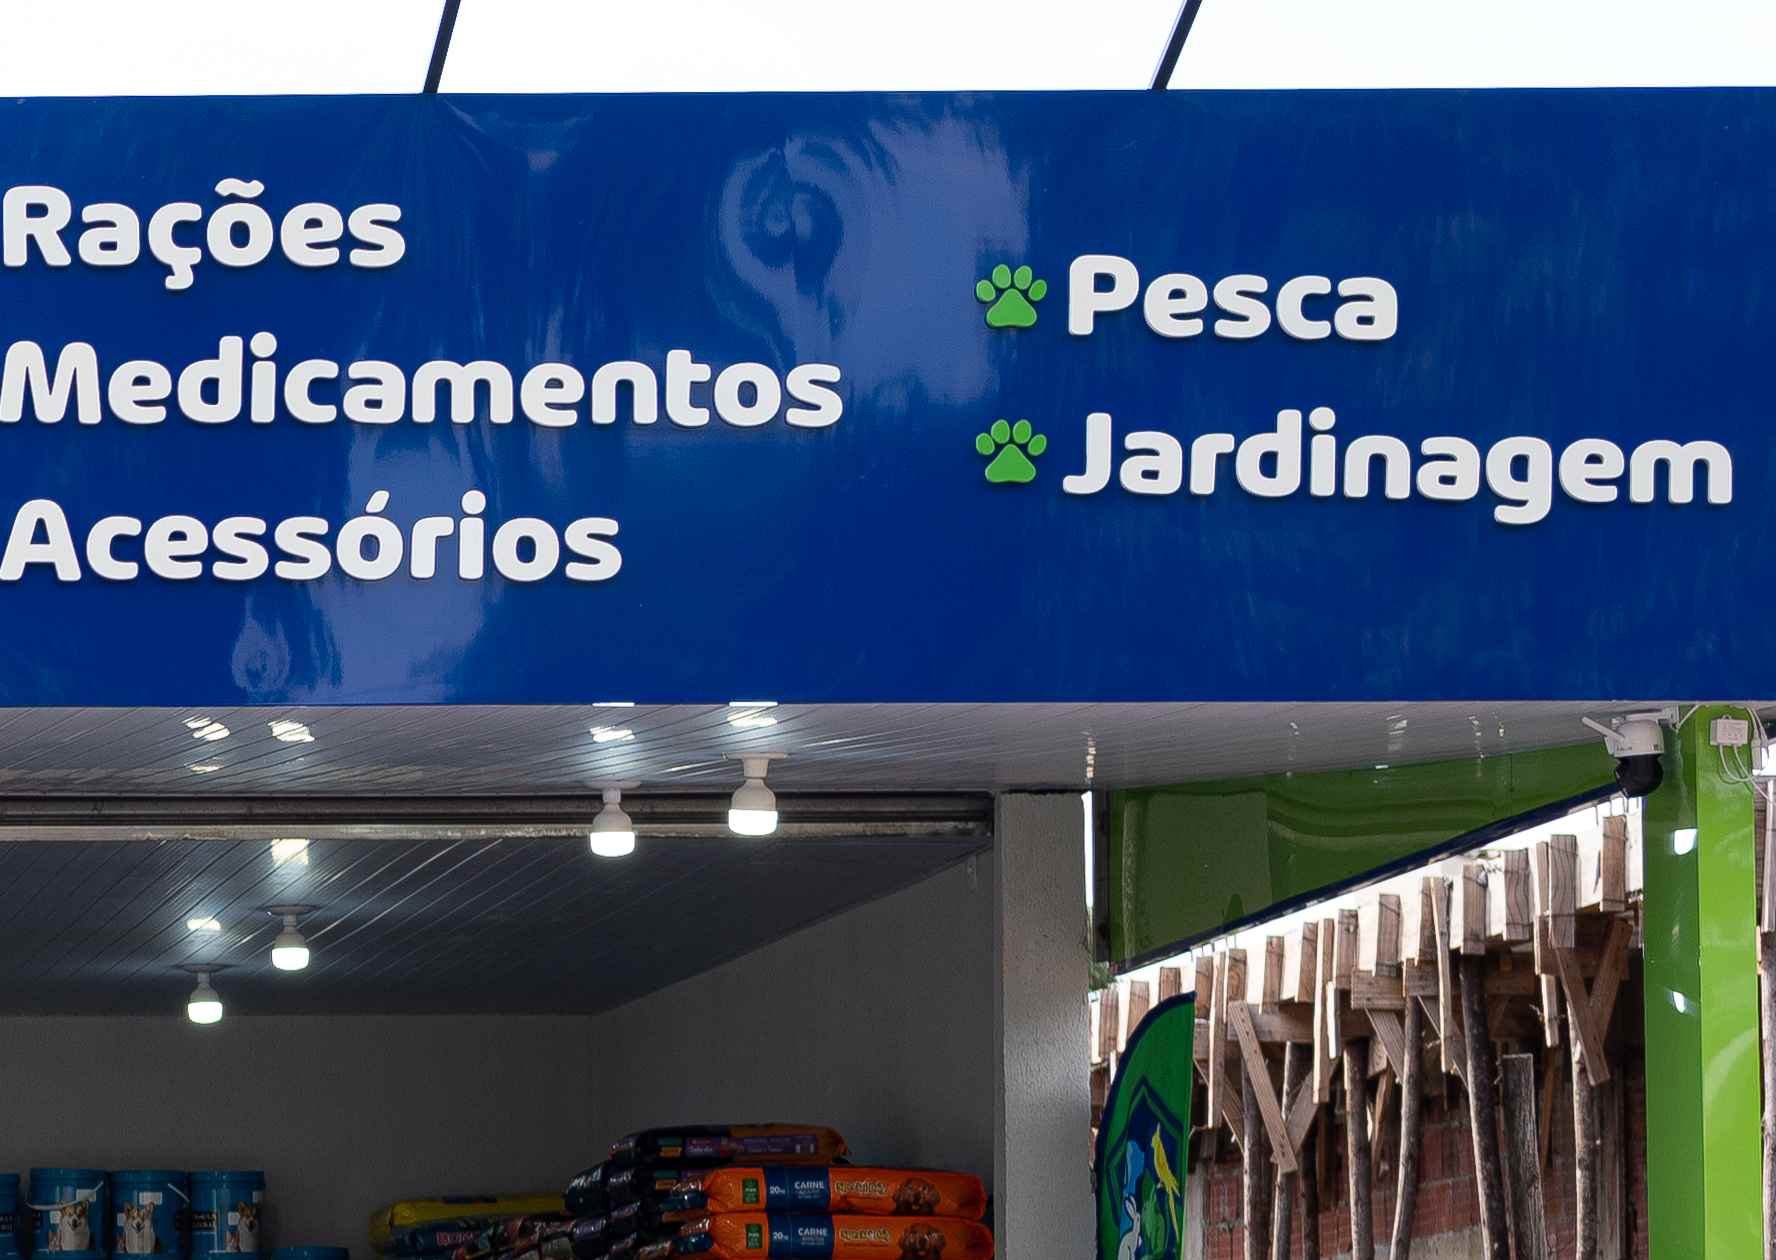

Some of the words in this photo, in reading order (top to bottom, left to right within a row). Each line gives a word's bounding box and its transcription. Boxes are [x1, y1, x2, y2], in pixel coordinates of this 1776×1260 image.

[0, 178, 408, 291] Rações
[1064, 252, 1400, 343] Pesca
[1060, 404, 1735, 526] Jardinagem
